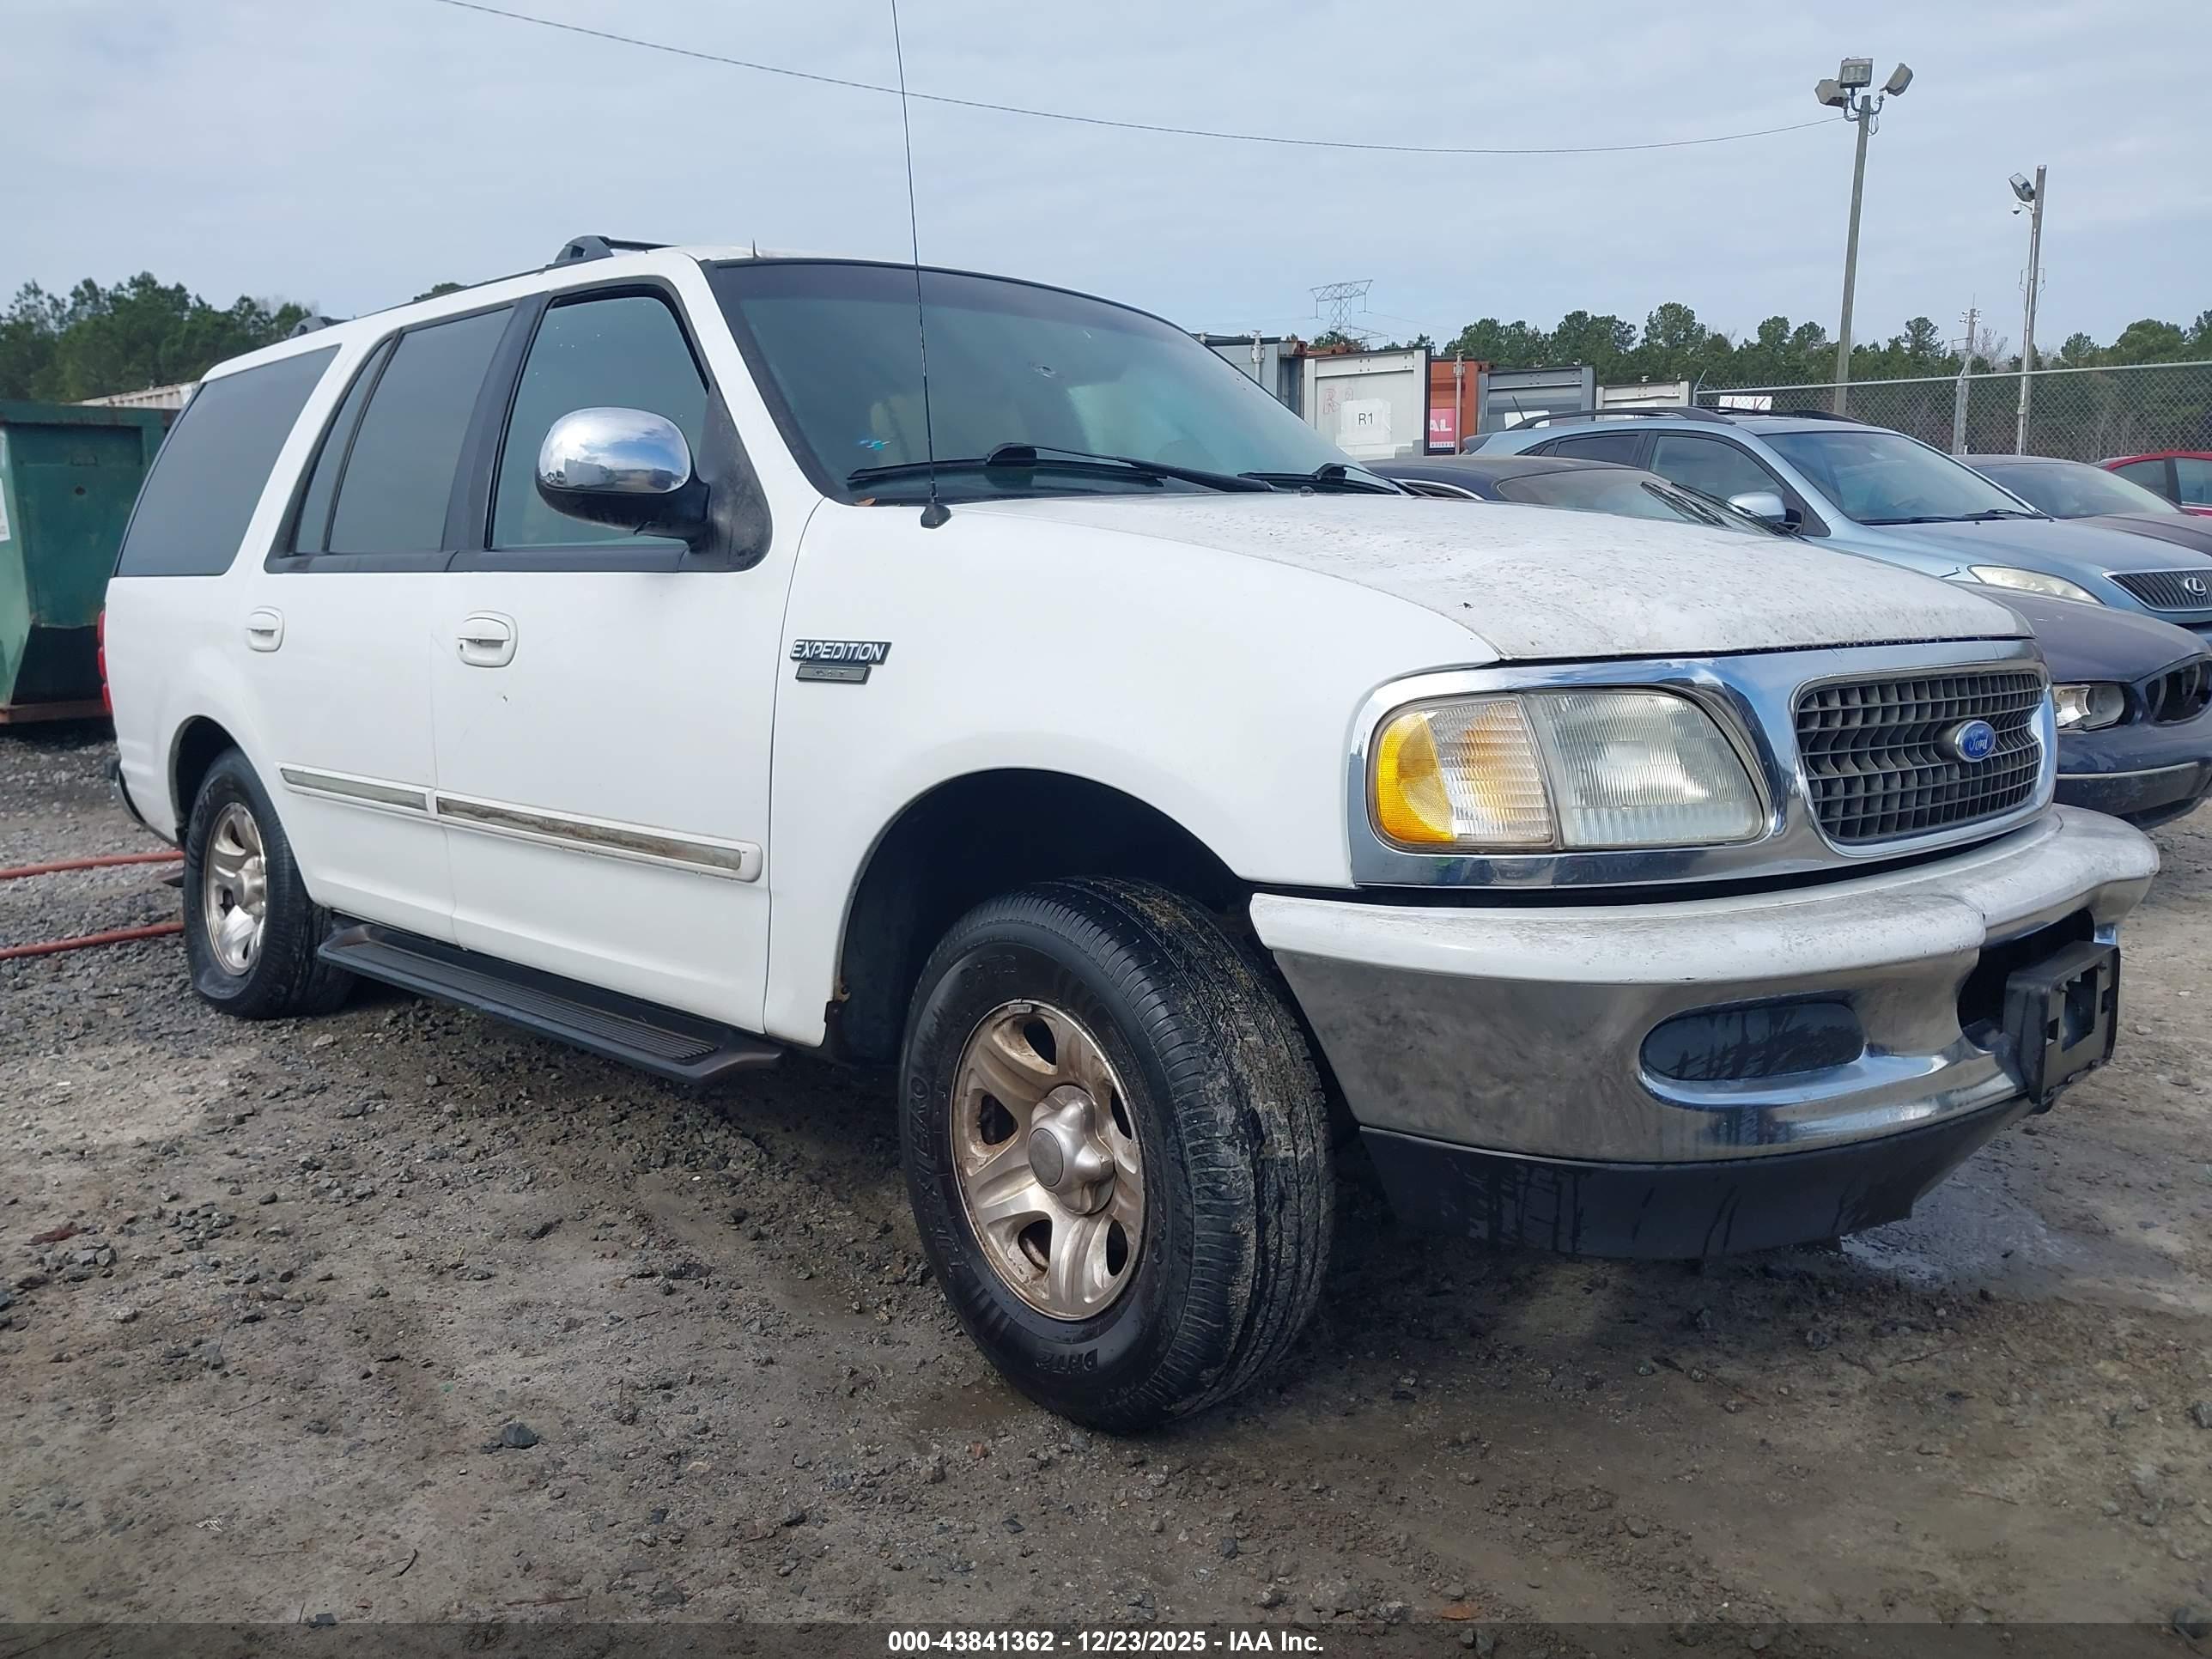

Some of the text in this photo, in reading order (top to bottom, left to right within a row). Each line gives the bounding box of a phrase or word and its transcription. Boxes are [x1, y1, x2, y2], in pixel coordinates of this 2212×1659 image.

[1358, 412, 1374, 426] R1
[790, 641, 886, 661] EXPEDITION
[1968, 727, 1989, 751] Ford
